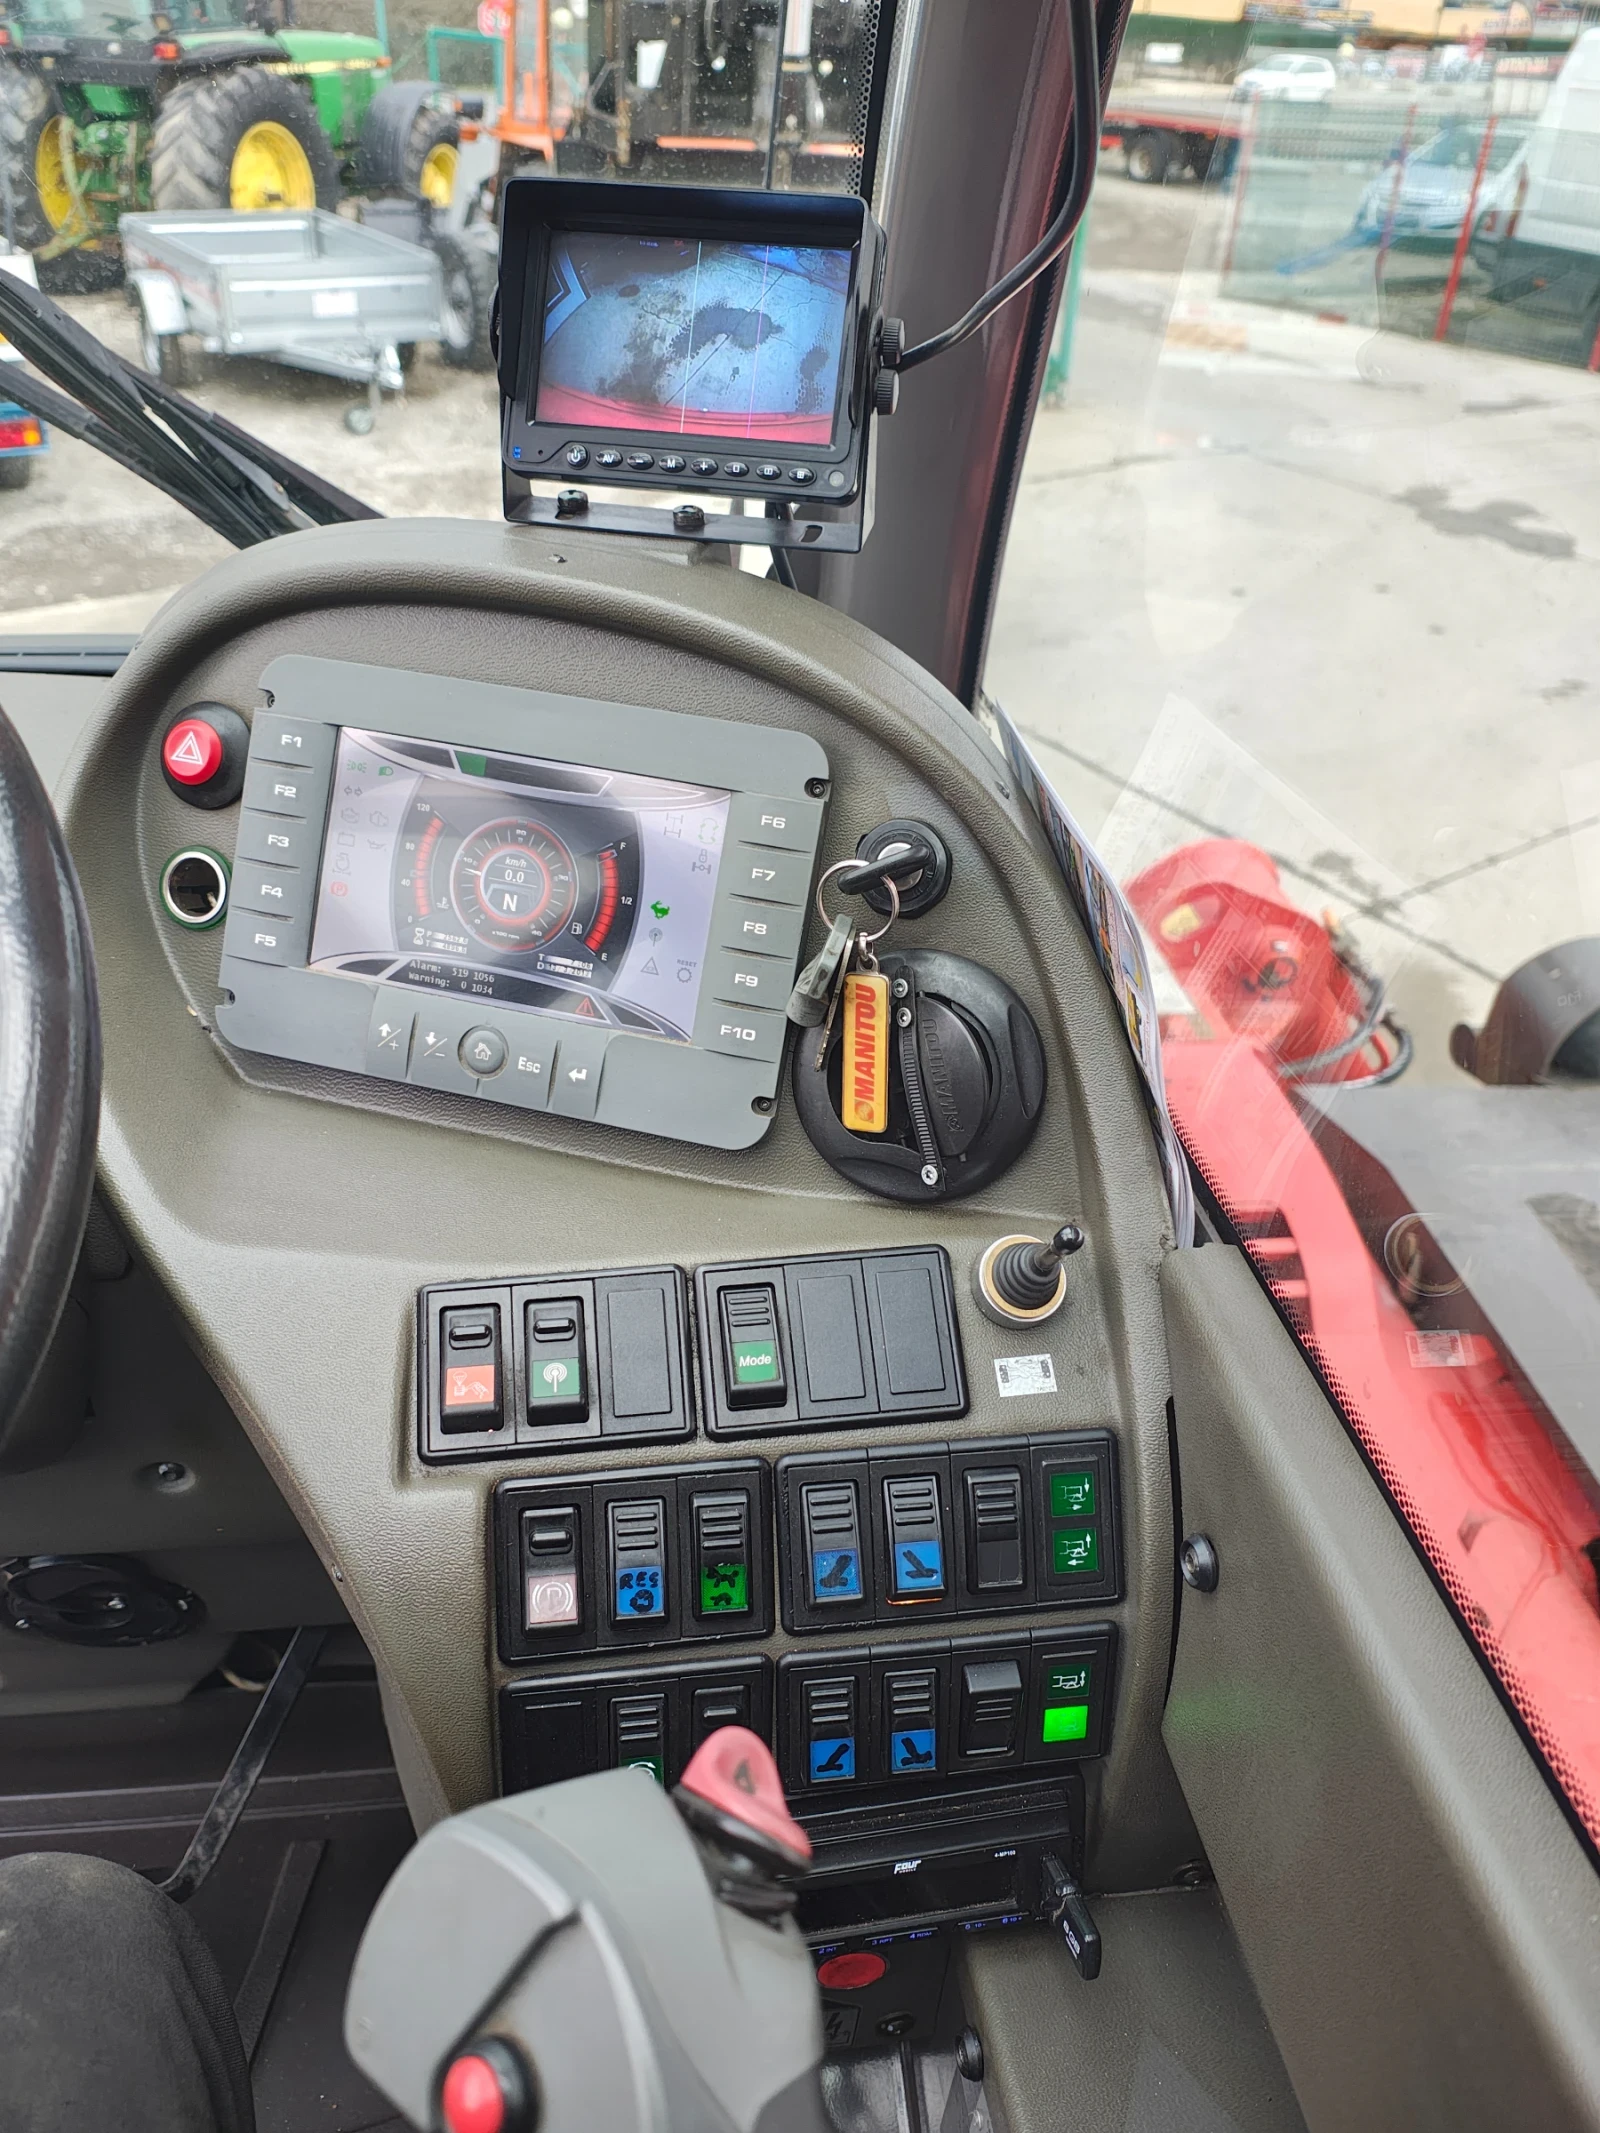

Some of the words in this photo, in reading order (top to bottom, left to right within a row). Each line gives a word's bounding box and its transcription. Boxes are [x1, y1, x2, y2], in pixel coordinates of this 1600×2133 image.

[602, 454, 614, 464] AV
[667, 458, 676, 468] M
[281, 734, 302, 748] F1
[274, 784, 297, 798] F2
[416, 803, 430, 812] 120
[761, 814, 786, 829] F6
[267, 834, 289, 848] F3
[405, 842, 415, 851] 80
[620, 842, 627, 850] F
[505, 857, 527, 868] km/h
[504, 869, 525, 883] 0.0
[751, 868, 776, 881] F7
[401, 879, 411, 887] 40
[261, 884, 283, 898] F4
[502, 893, 517, 912] N
[621, 896, 633, 906] 1/2
[743, 921, 767, 935] F8
[254, 933, 276, 947] F5
[538, 953, 545, 961] T
[601, 953, 608, 961] E
[410, 960, 441, 973] Alarm:
[452, 967, 469, 978] 519
[473, 972, 495, 983] 1056
[537, 962, 545, 970] D
[408, 972, 450, 988] Warning:
[471, 983, 493, 995] 1034
[734, 973, 758, 987] F9
[720, 1024, 756, 1041] F10
[854, 983, 876, 1102] MANITOU
[518, 1056, 541, 1074] Esc
[922, 1018, 959, 1115] MANITOU
[739, 1353, 772, 1367] Mode
[619, 1571, 659, 1590] RES
